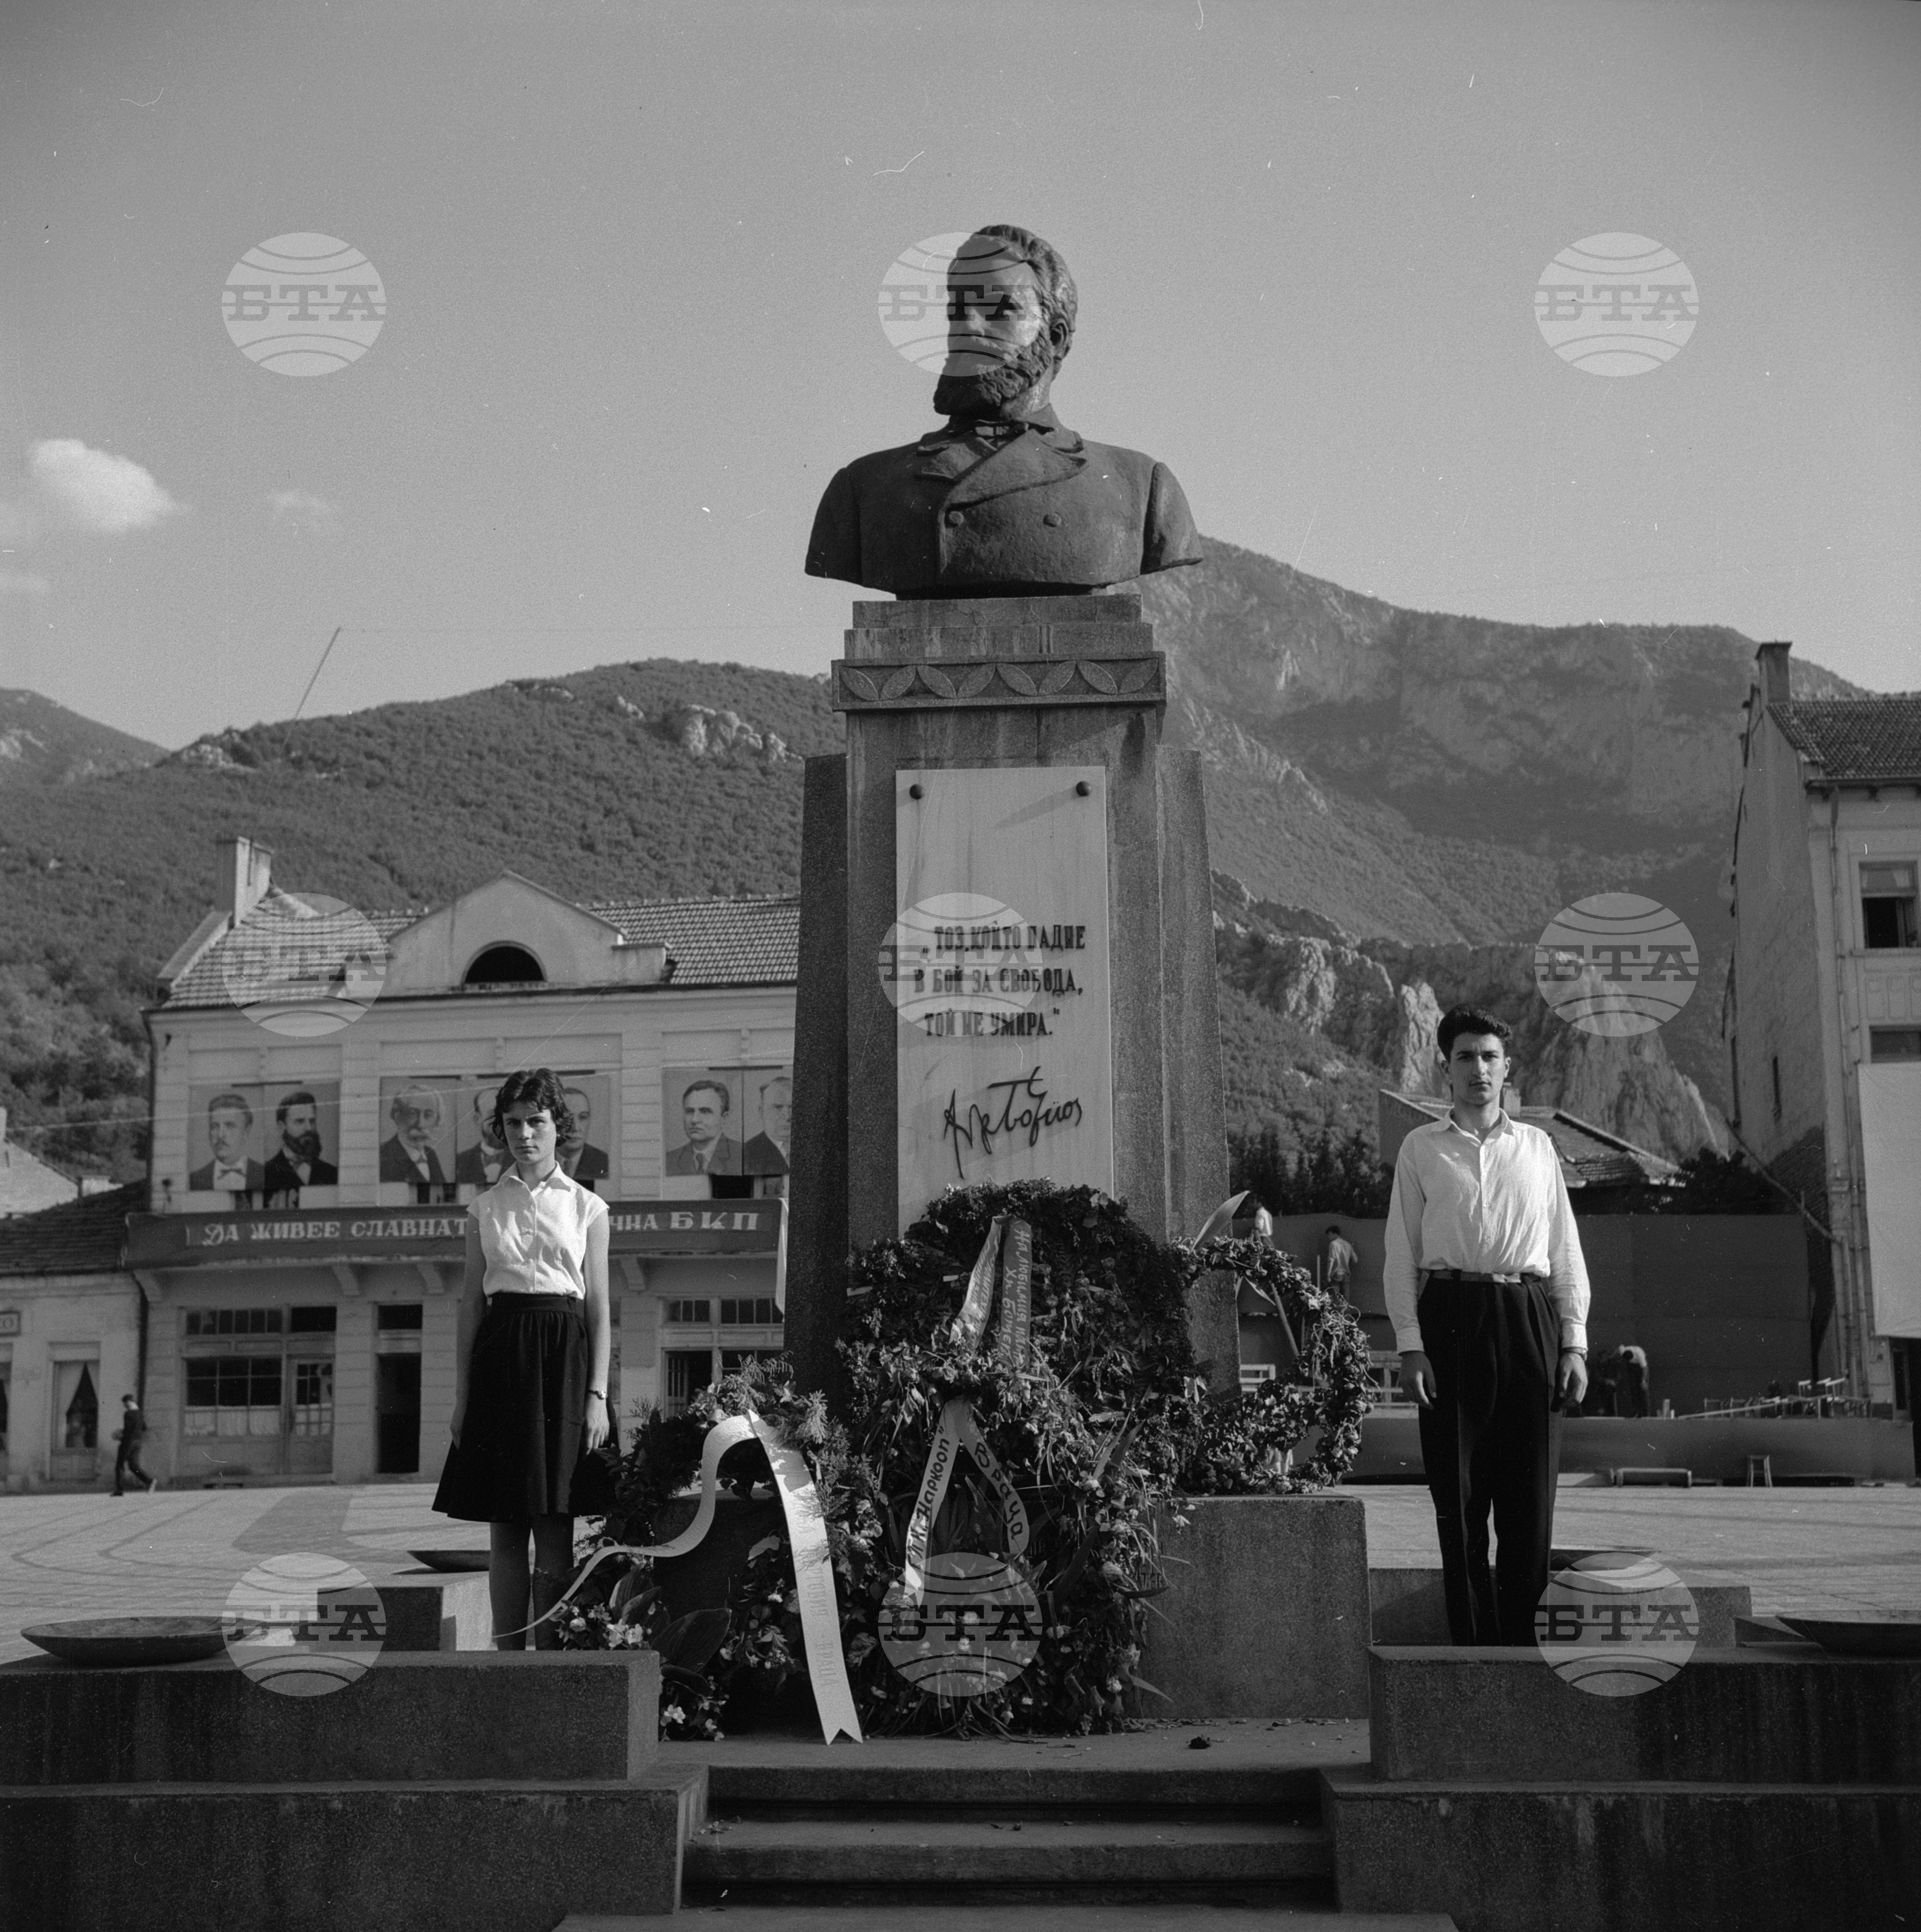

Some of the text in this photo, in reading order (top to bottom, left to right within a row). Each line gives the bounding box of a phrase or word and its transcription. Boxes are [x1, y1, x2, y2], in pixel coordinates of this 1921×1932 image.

[914, 968, 925, 993] В
[933, 966, 963, 993] БОЙ
[972, 969, 993, 993] ЗА
[925, 1008, 955, 1036] ТОЙ
[962, 1012, 983, 1036] НЕ
[201, 1224, 240, 1246] ДА
[250, 1222, 340, 1240] ЖИВЕЕ
[351, 1218, 468, 1238] СЛАВНАТ
[670, 1212, 759, 1230] БКП
[974, 1442, 1024, 1540] Враца
